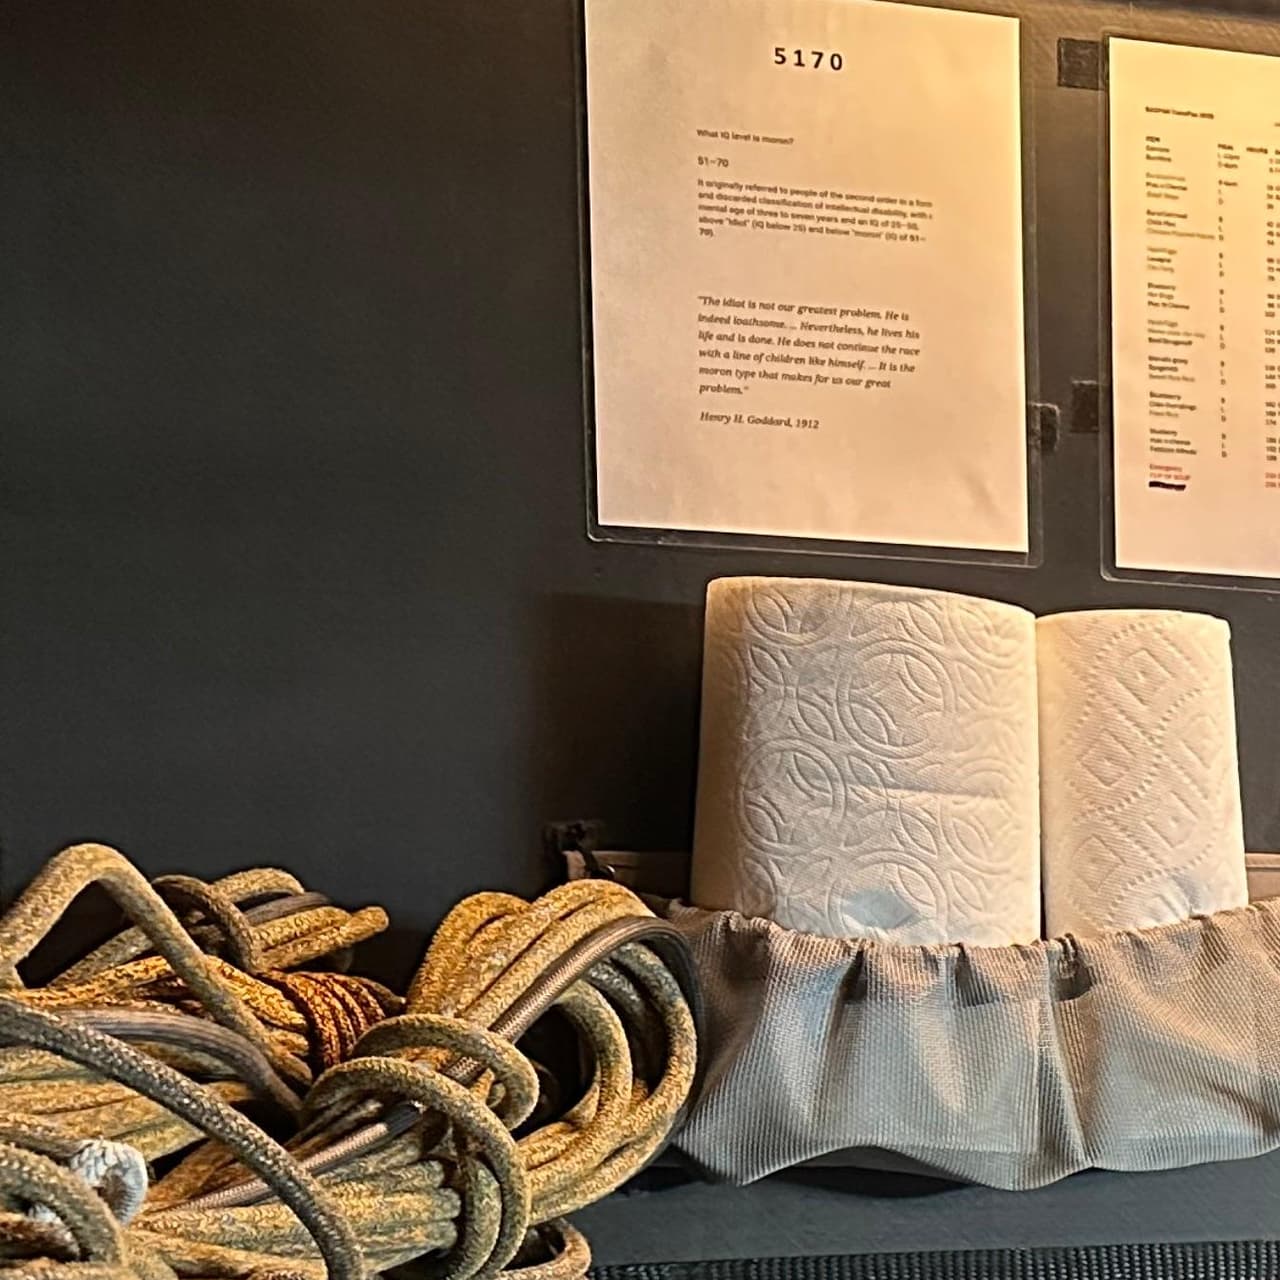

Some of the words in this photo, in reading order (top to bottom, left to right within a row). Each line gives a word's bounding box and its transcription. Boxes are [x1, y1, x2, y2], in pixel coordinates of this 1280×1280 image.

[696, 129, 718, 137] What
[720, 131, 729, 139] IQ
[731, 131, 750, 141] level
[761, 136, 793, 144] moron?
[722, 297, 745, 308] idiot
[747, 300, 756, 309] is
[758, 302, 775, 310] not
[777, 303, 795, 312] our
[797, 305, 837, 315] greatest
[839, 308, 881, 319] problem.
[884, 310, 898, 320] He
[901, 312, 909, 321] is
[697, 313, 730, 324] indeed
[800, 321, 863, 335] Nevertheless,
[867, 326, 878, 336] he
[881, 327, 902, 337] lives
[905, 329, 919, 339] his
[698, 330, 713, 342] life
[715, 332, 735, 342] and
[737, 333, 745, 342] is
[747, 334, 774, 344] done.
[777, 336, 791, 346] He
[793, 337, 815, 348] does
[818, 341, 834, 349] not
[836, 342, 878, 352] continue
[881, 344, 896, 354] the
[899, 347, 920, 355] race
[698, 349, 720, 358] with
[723, 351, 730, 359] a
[732, 350, 750, 360] line
[752, 352, 764, 363] of
[765, 352, 805, 364] children
[808, 355, 825, 366] like
[827, 357, 865, 371] himself.
[878, 361, 886, 370] It
[889, 362, 897, 371] is
[900, 363, 915, 372] the
[698, 366, 731, 376] moron
[734, 368, 755, 380] type
[758, 369, 778, 380] that
[781, 372, 812, 382] makes
[813, 373, 829, 384] for
[831, 376, 843, 384] us
[845, 377, 863, 386] our
[864, 379, 890, 388] great
[700, 411, 731, 424] Henry
[747, 415, 792, 427] Goddard,
[795, 418, 819, 429] 1912
